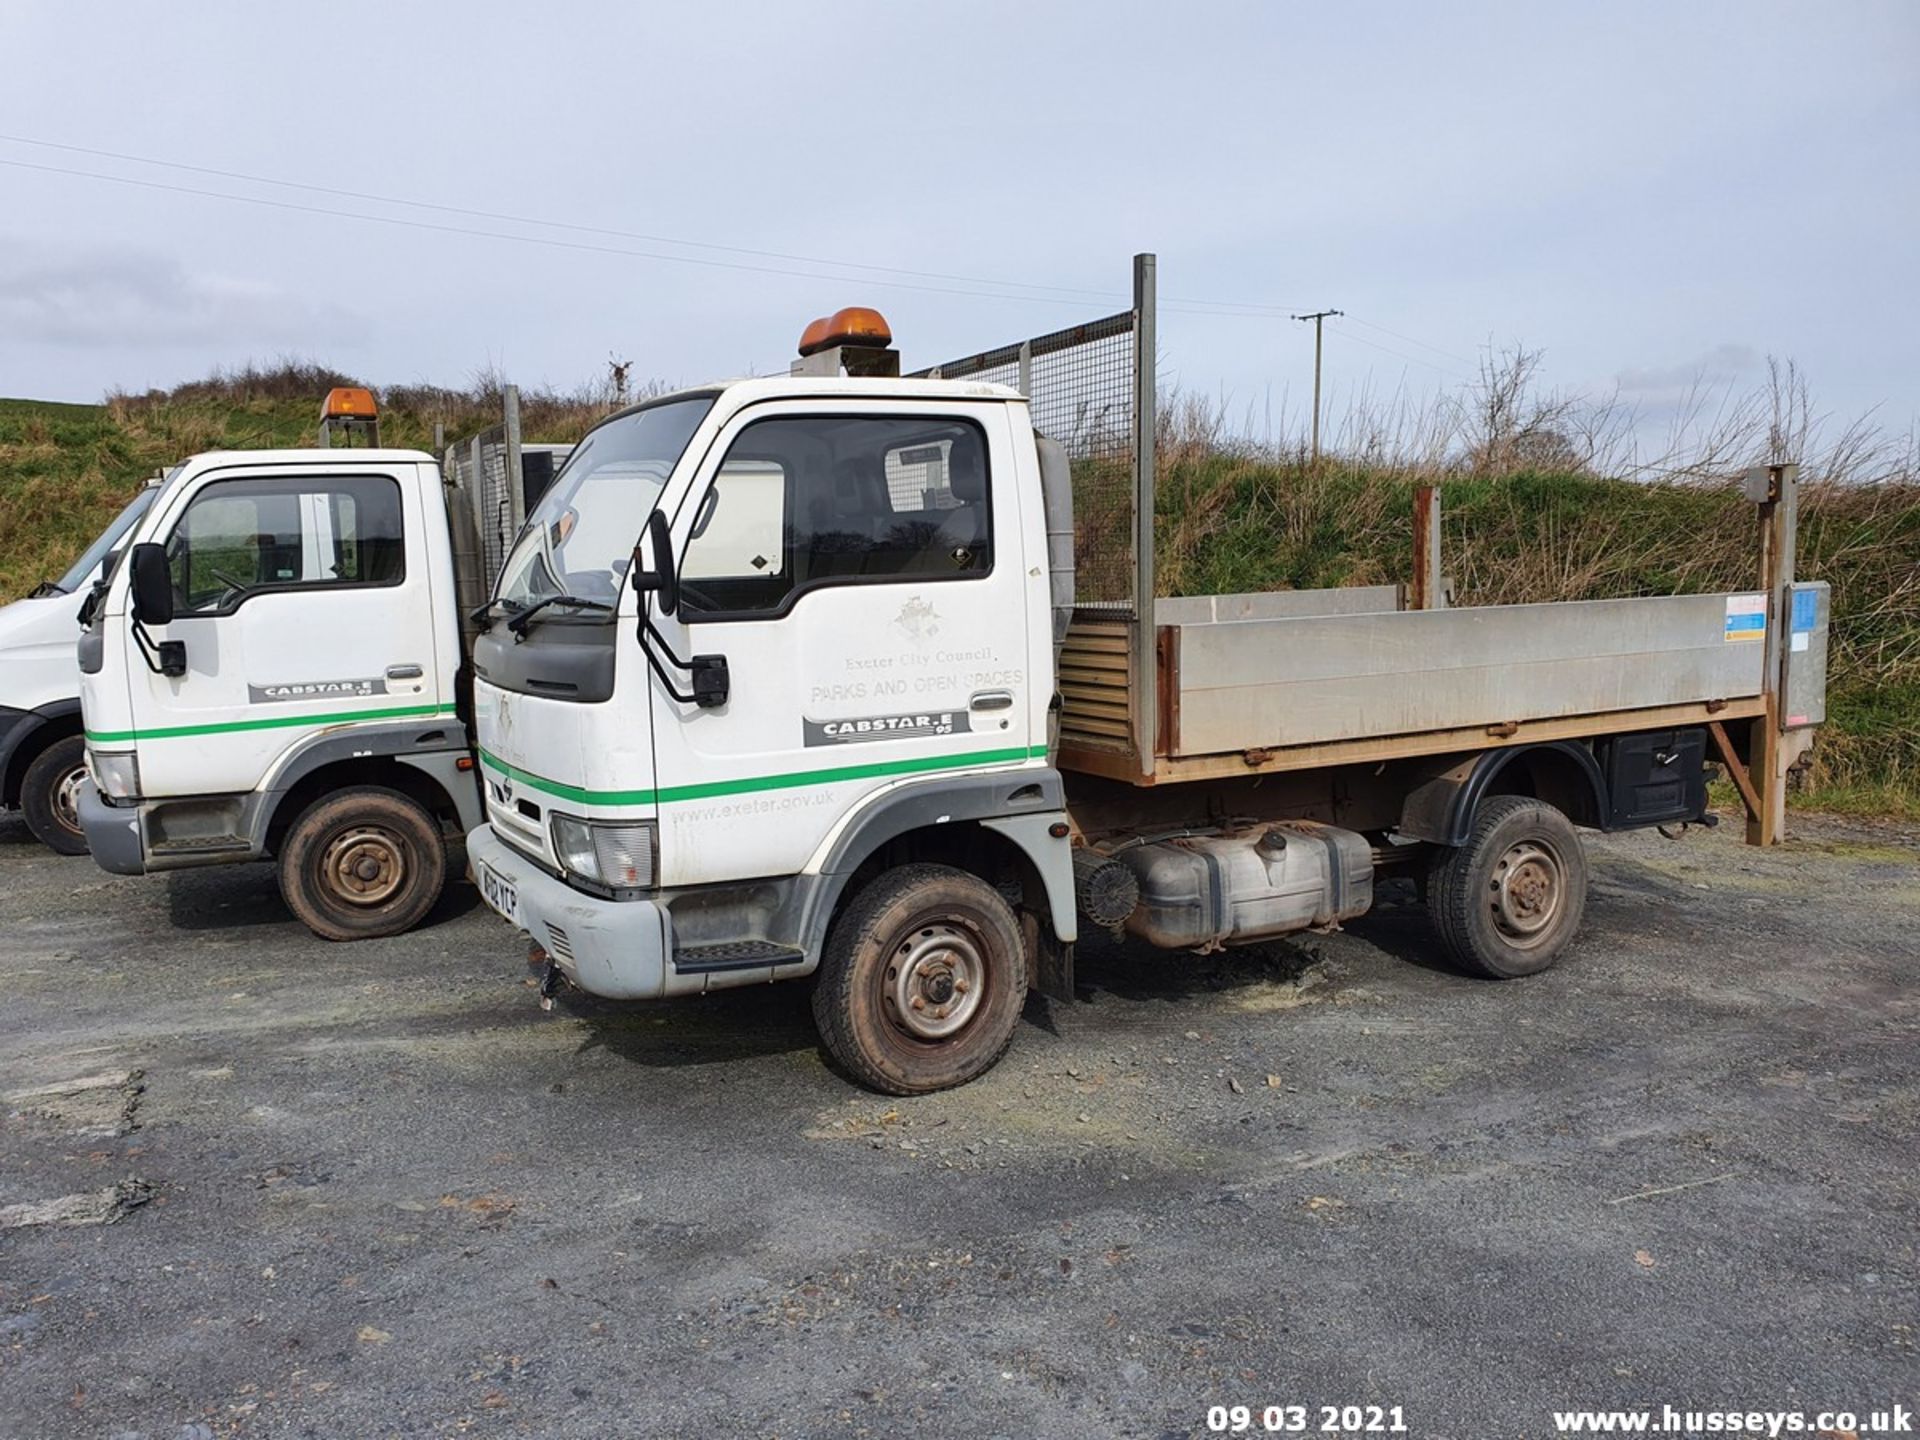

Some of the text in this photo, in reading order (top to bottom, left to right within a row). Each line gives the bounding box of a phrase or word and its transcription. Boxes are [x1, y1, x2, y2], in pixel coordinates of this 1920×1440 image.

[846, 647, 991, 670] Exeter City Council
[811, 669, 1024, 702] PARKS AND OPEN SPACES
[935, 724, 953, 734] 95
